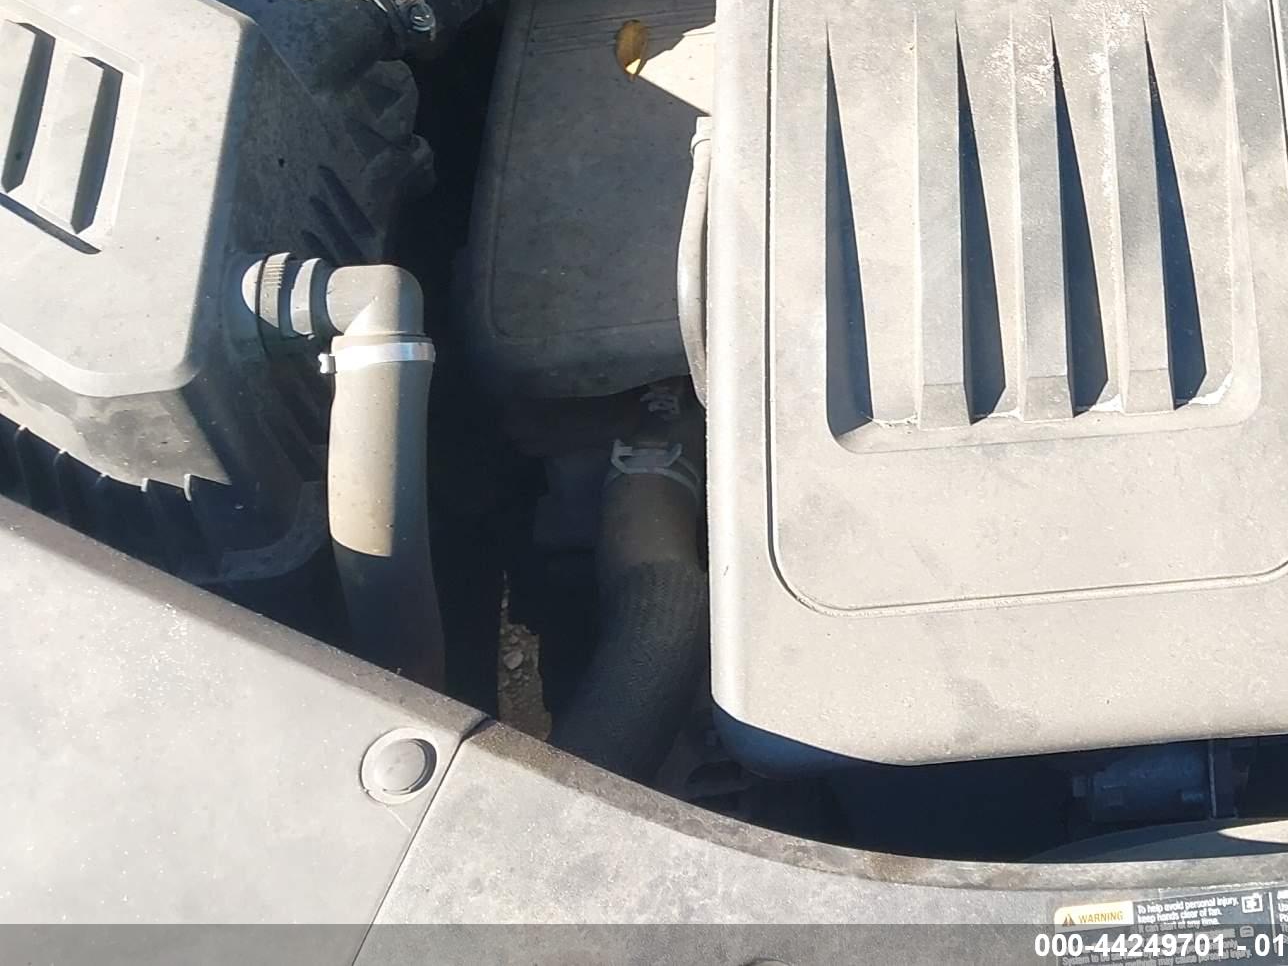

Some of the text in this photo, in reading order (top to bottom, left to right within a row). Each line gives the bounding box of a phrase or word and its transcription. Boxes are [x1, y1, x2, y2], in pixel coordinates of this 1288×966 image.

[1137, 905, 1146, 913] To
[1164, 901, 1184, 910] avoid
[1184, 898, 1215, 909] personal
[1199, 909, 1207, 917] of
[1077, 910, 1124, 925] WARNING
